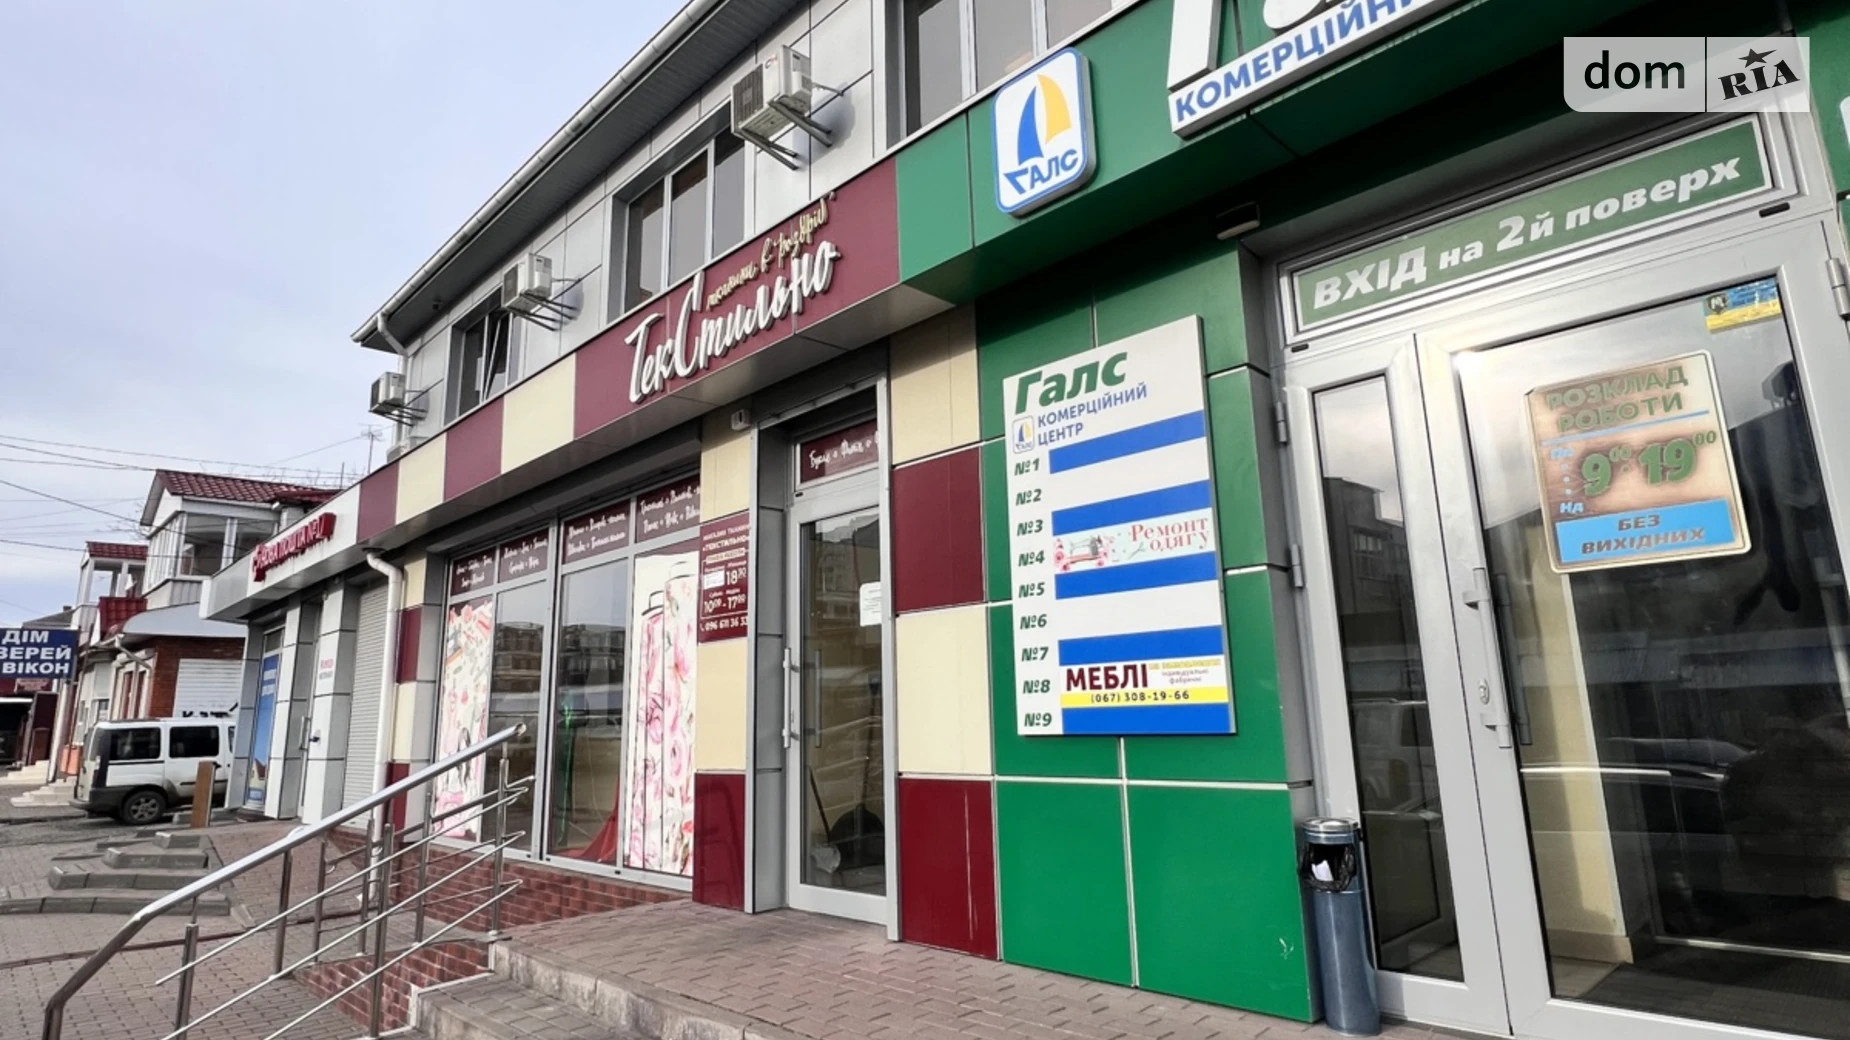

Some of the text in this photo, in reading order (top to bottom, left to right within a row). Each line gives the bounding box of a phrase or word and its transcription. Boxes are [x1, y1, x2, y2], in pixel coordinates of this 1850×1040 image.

[1313, 156, 1741, 309] ВХІД на 2й поверх
[1015, 352, 1128, 415] Галс
[1546, 366, 1689, 411] РОЗКЛАД
[1037, 382, 1148, 428] КОМЕРЦІЙНИЙ
[1558, 392, 1683, 432] РОБОТИ
[1038, 422, 1084, 446] ЦЕНТР
[1014, 458, 1040, 476] №1
[1015, 488, 1043, 506] №2
[1016, 519, 1044, 536] №3
[1130, 518, 1209, 542] Ремонт
[1617, 514, 1661, 531] БЕЗ
[1150, 530, 1211, 551] одягу
[1581, 526, 1705, 555] ВИХІДНИХ
[1018, 550, 1046, 567] №4
[1018, 582, 1046, 598] №5
[1020, 614, 1047, 630] №6
[2, 630, 49, 645] ДІМ
[1021, 647, 1049, 662] №7
[2, 662, 70, 674] ВІКОН
[1065, 663, 1149, 691] МЕБЛІ
[1022, 679, 1050, 694] №8
[1091, 690, 1190, 703] (067) 308-19-66
[1024, 712, 1052, 727] №9
